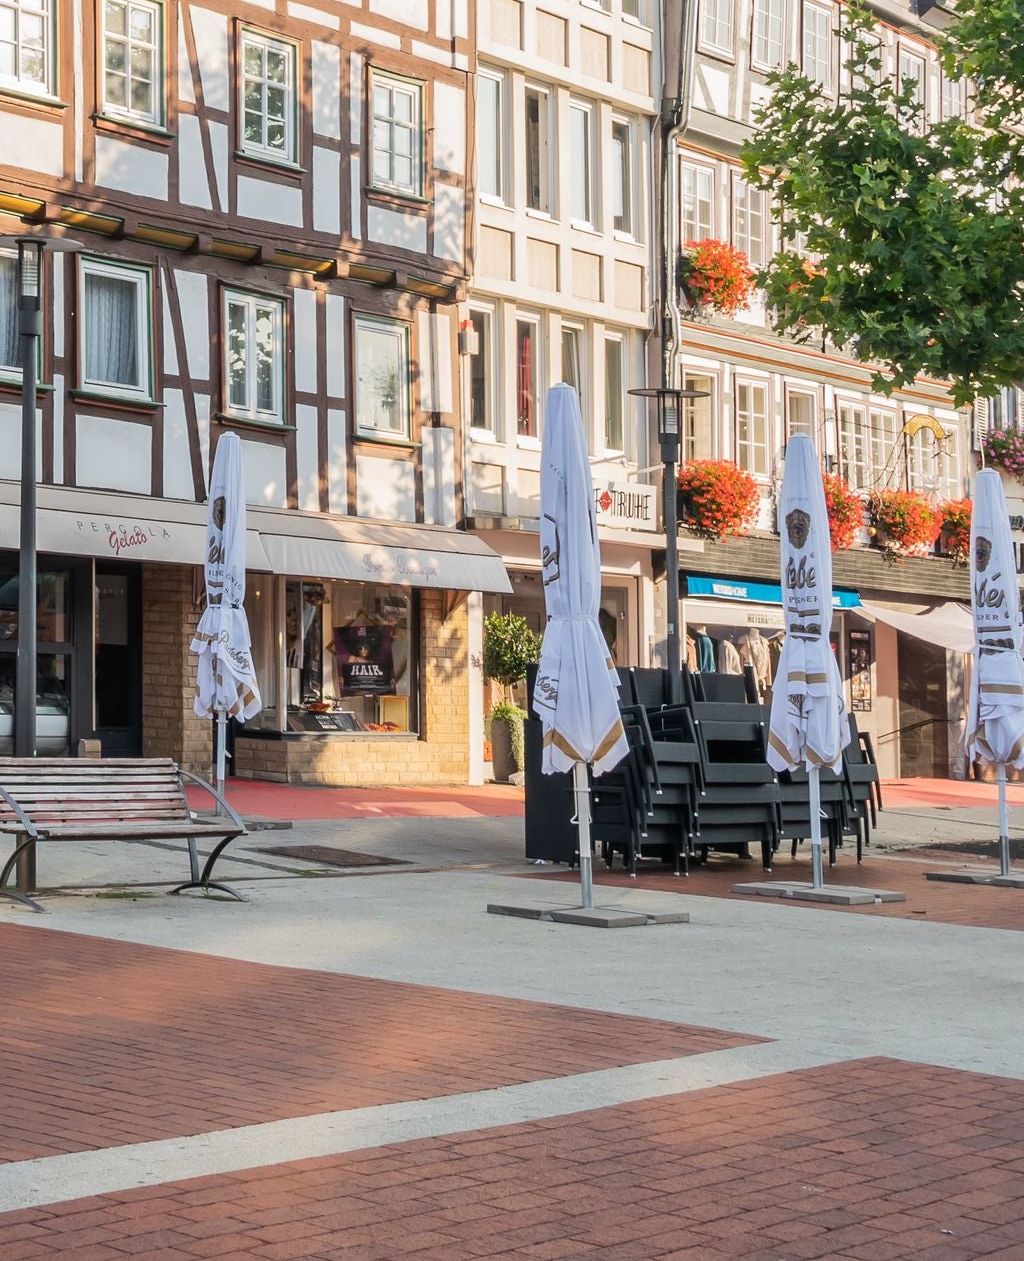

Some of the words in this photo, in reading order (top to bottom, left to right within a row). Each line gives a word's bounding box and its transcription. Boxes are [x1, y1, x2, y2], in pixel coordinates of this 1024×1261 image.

[77, 521, 169, 538] PERGOLA
[109, 531, 147, 555] Gelato
[350, 664, 384, 676] HAIR
